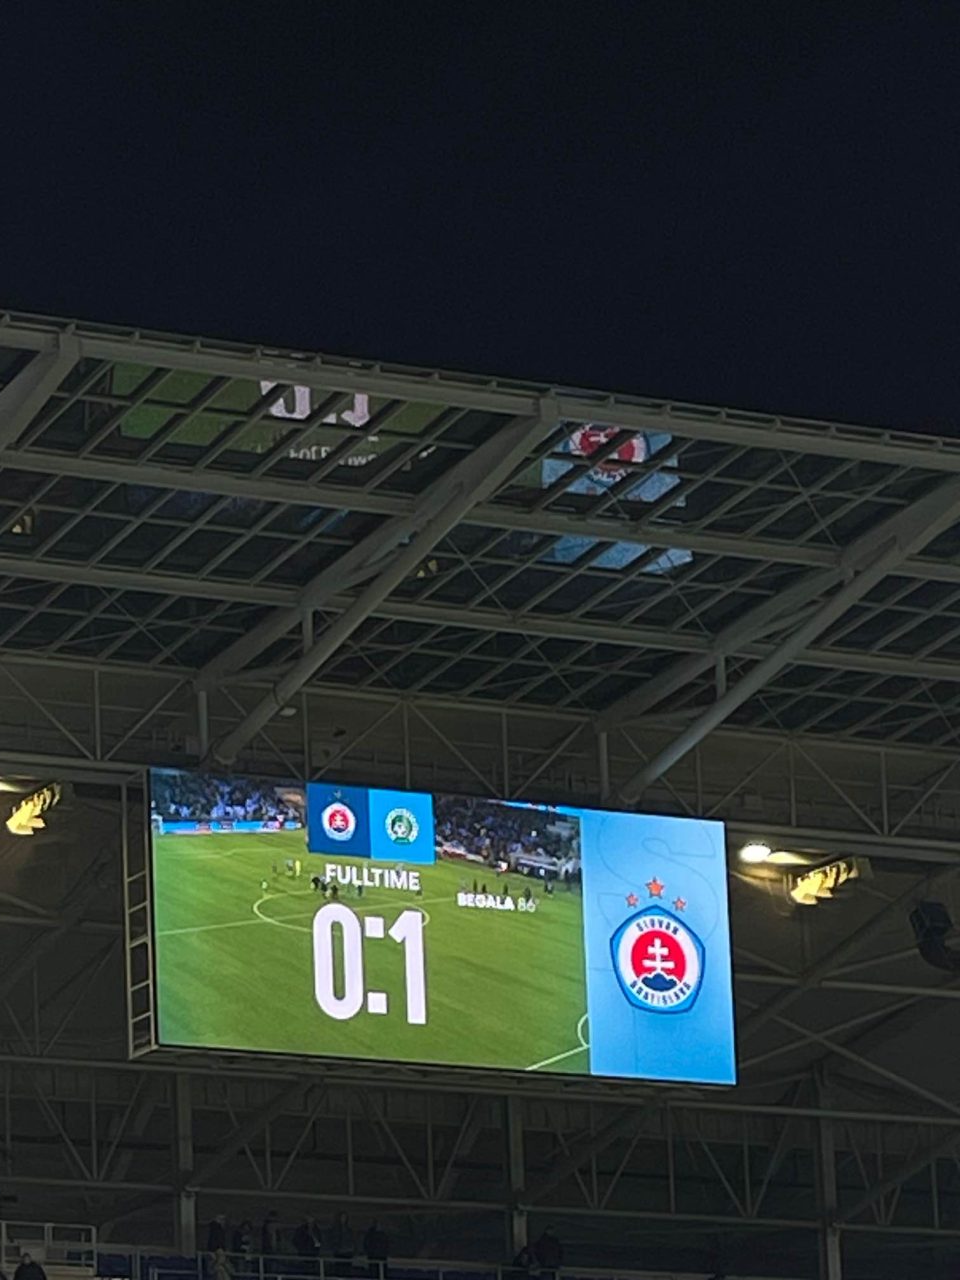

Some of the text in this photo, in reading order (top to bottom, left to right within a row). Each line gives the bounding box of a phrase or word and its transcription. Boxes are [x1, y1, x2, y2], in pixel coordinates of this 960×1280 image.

[325, 863, 421, 891] FULLTIME
[457, 892, 516, 911] BEGALA
[312, 903, 427, 1024] 0:1
